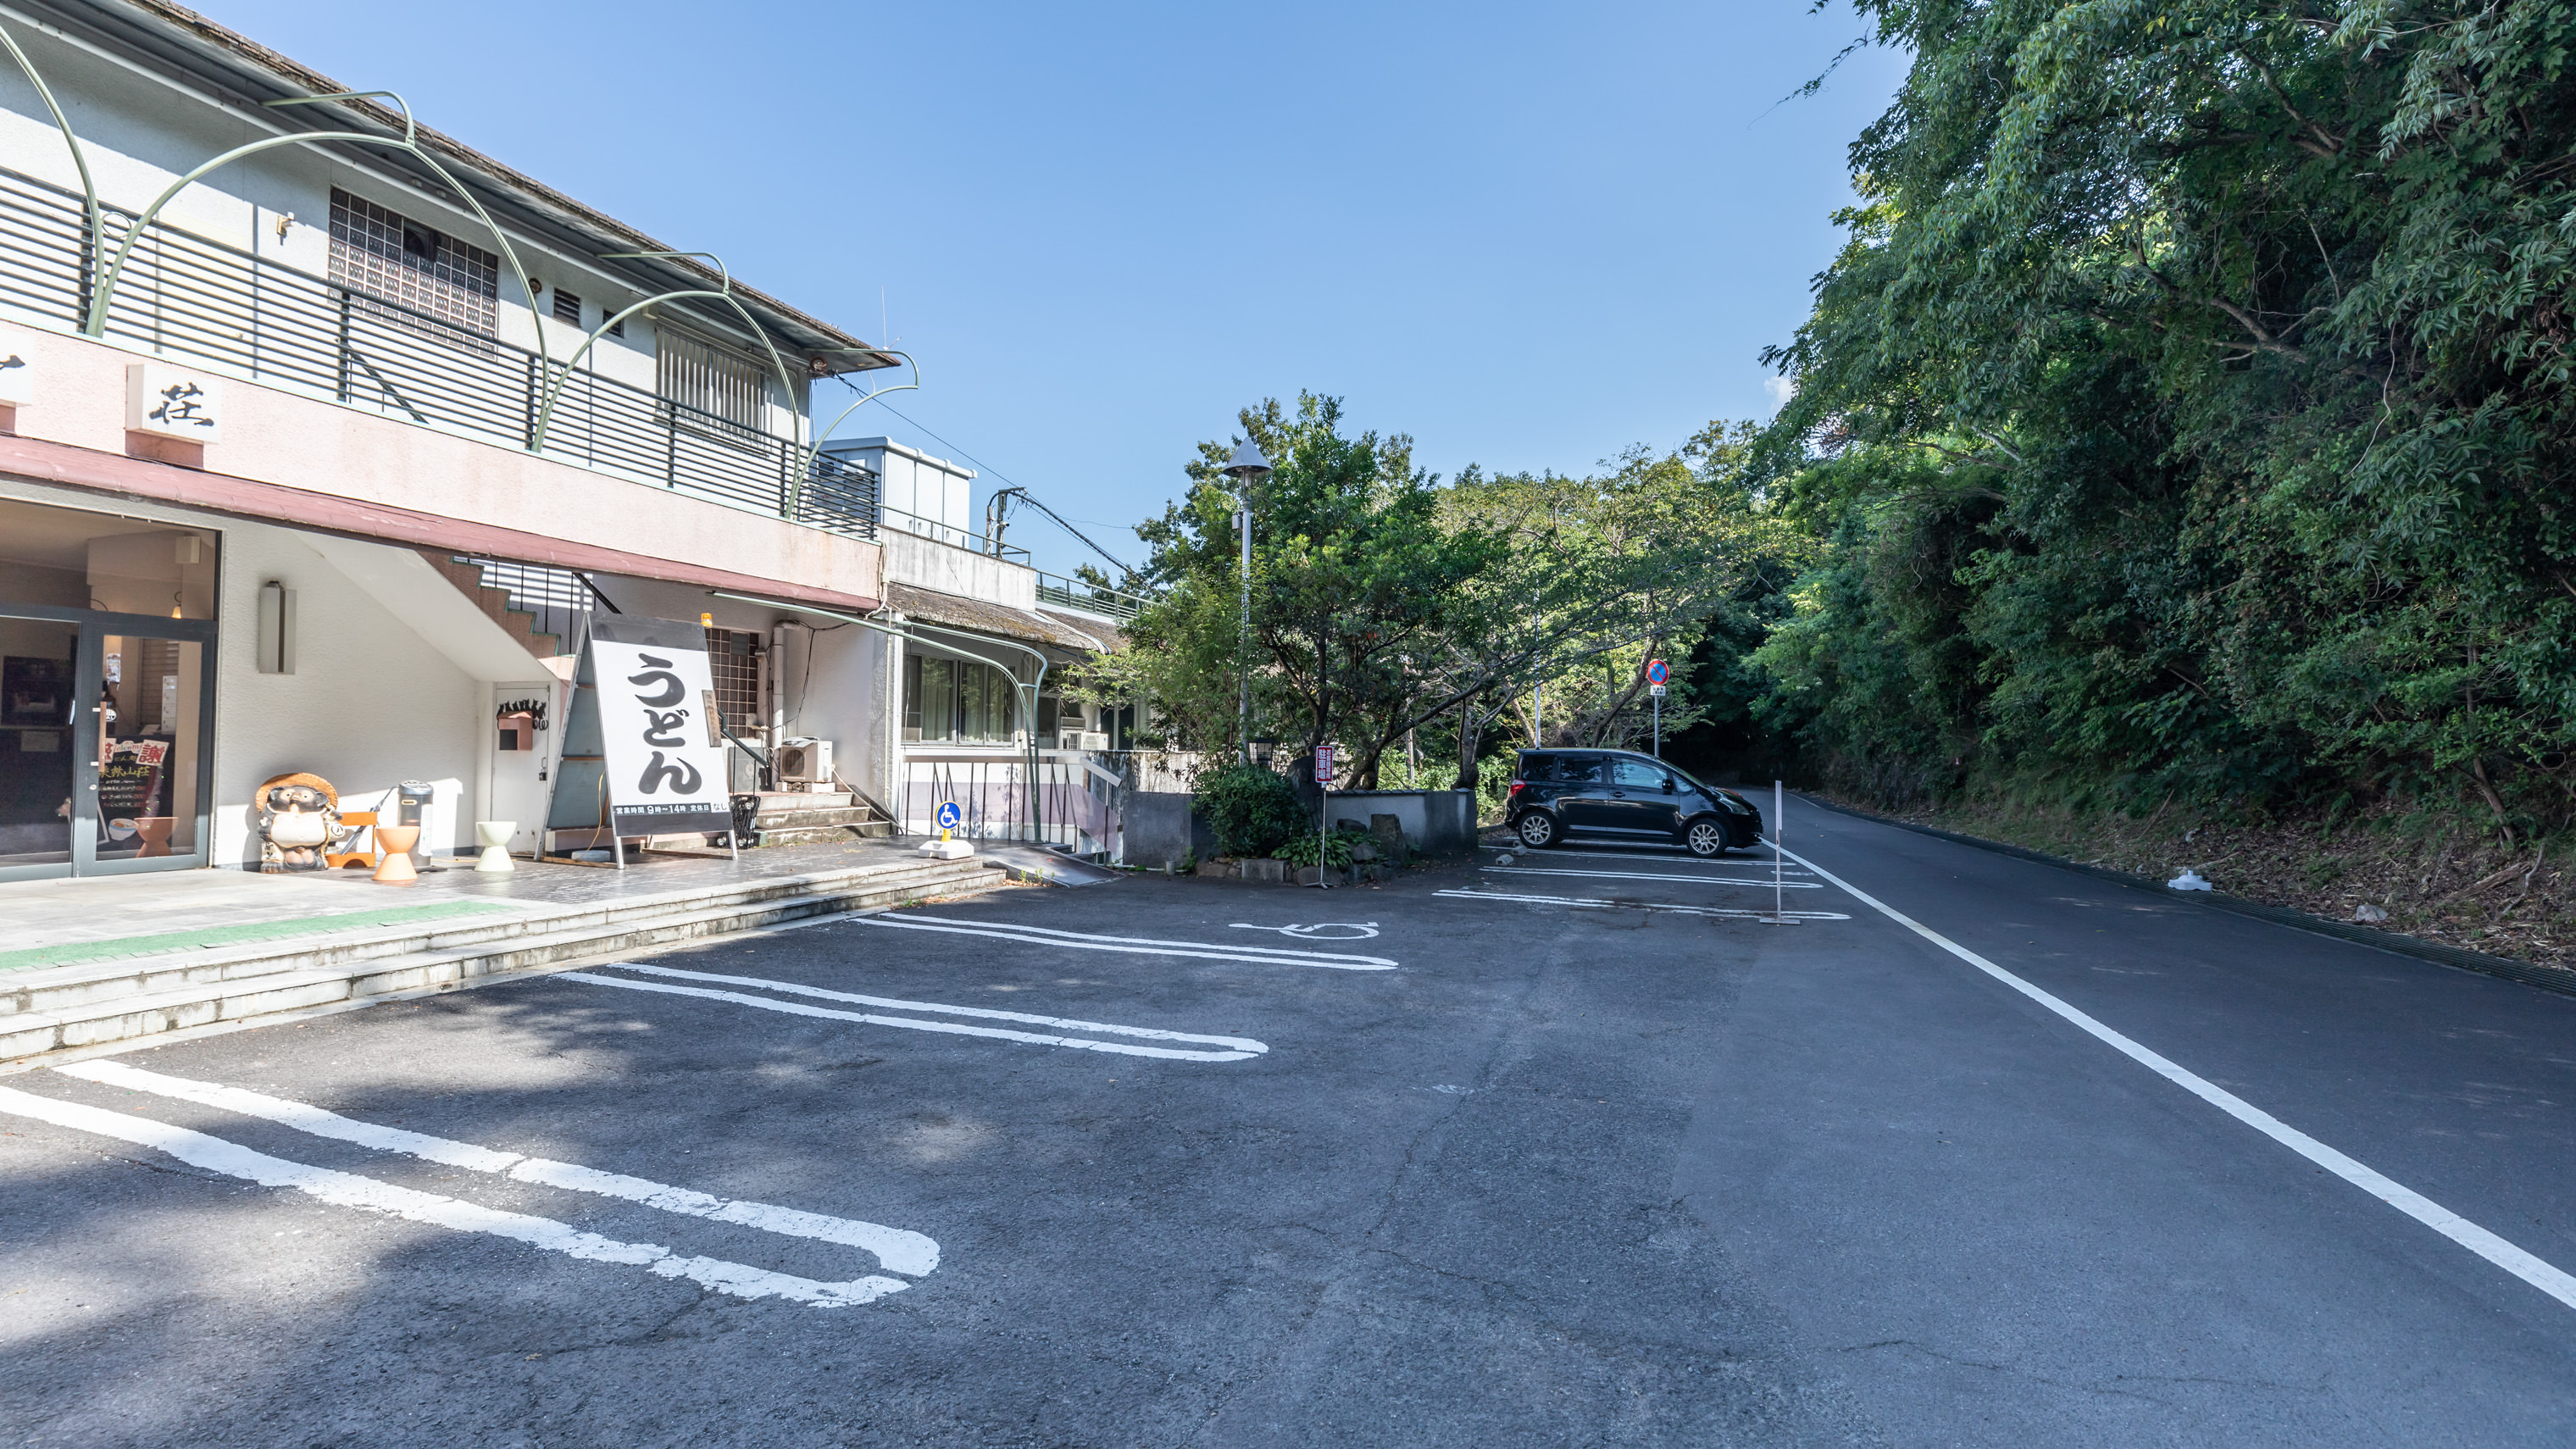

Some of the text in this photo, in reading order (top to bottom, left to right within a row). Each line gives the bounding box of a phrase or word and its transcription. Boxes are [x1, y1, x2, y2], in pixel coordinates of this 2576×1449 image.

[148, 380, 214, 427] 荘
[627, 652, 702, 795] うどん
[616, 806, 645, 814] 営業時間
[690, 803, 710, 812] 定休日
